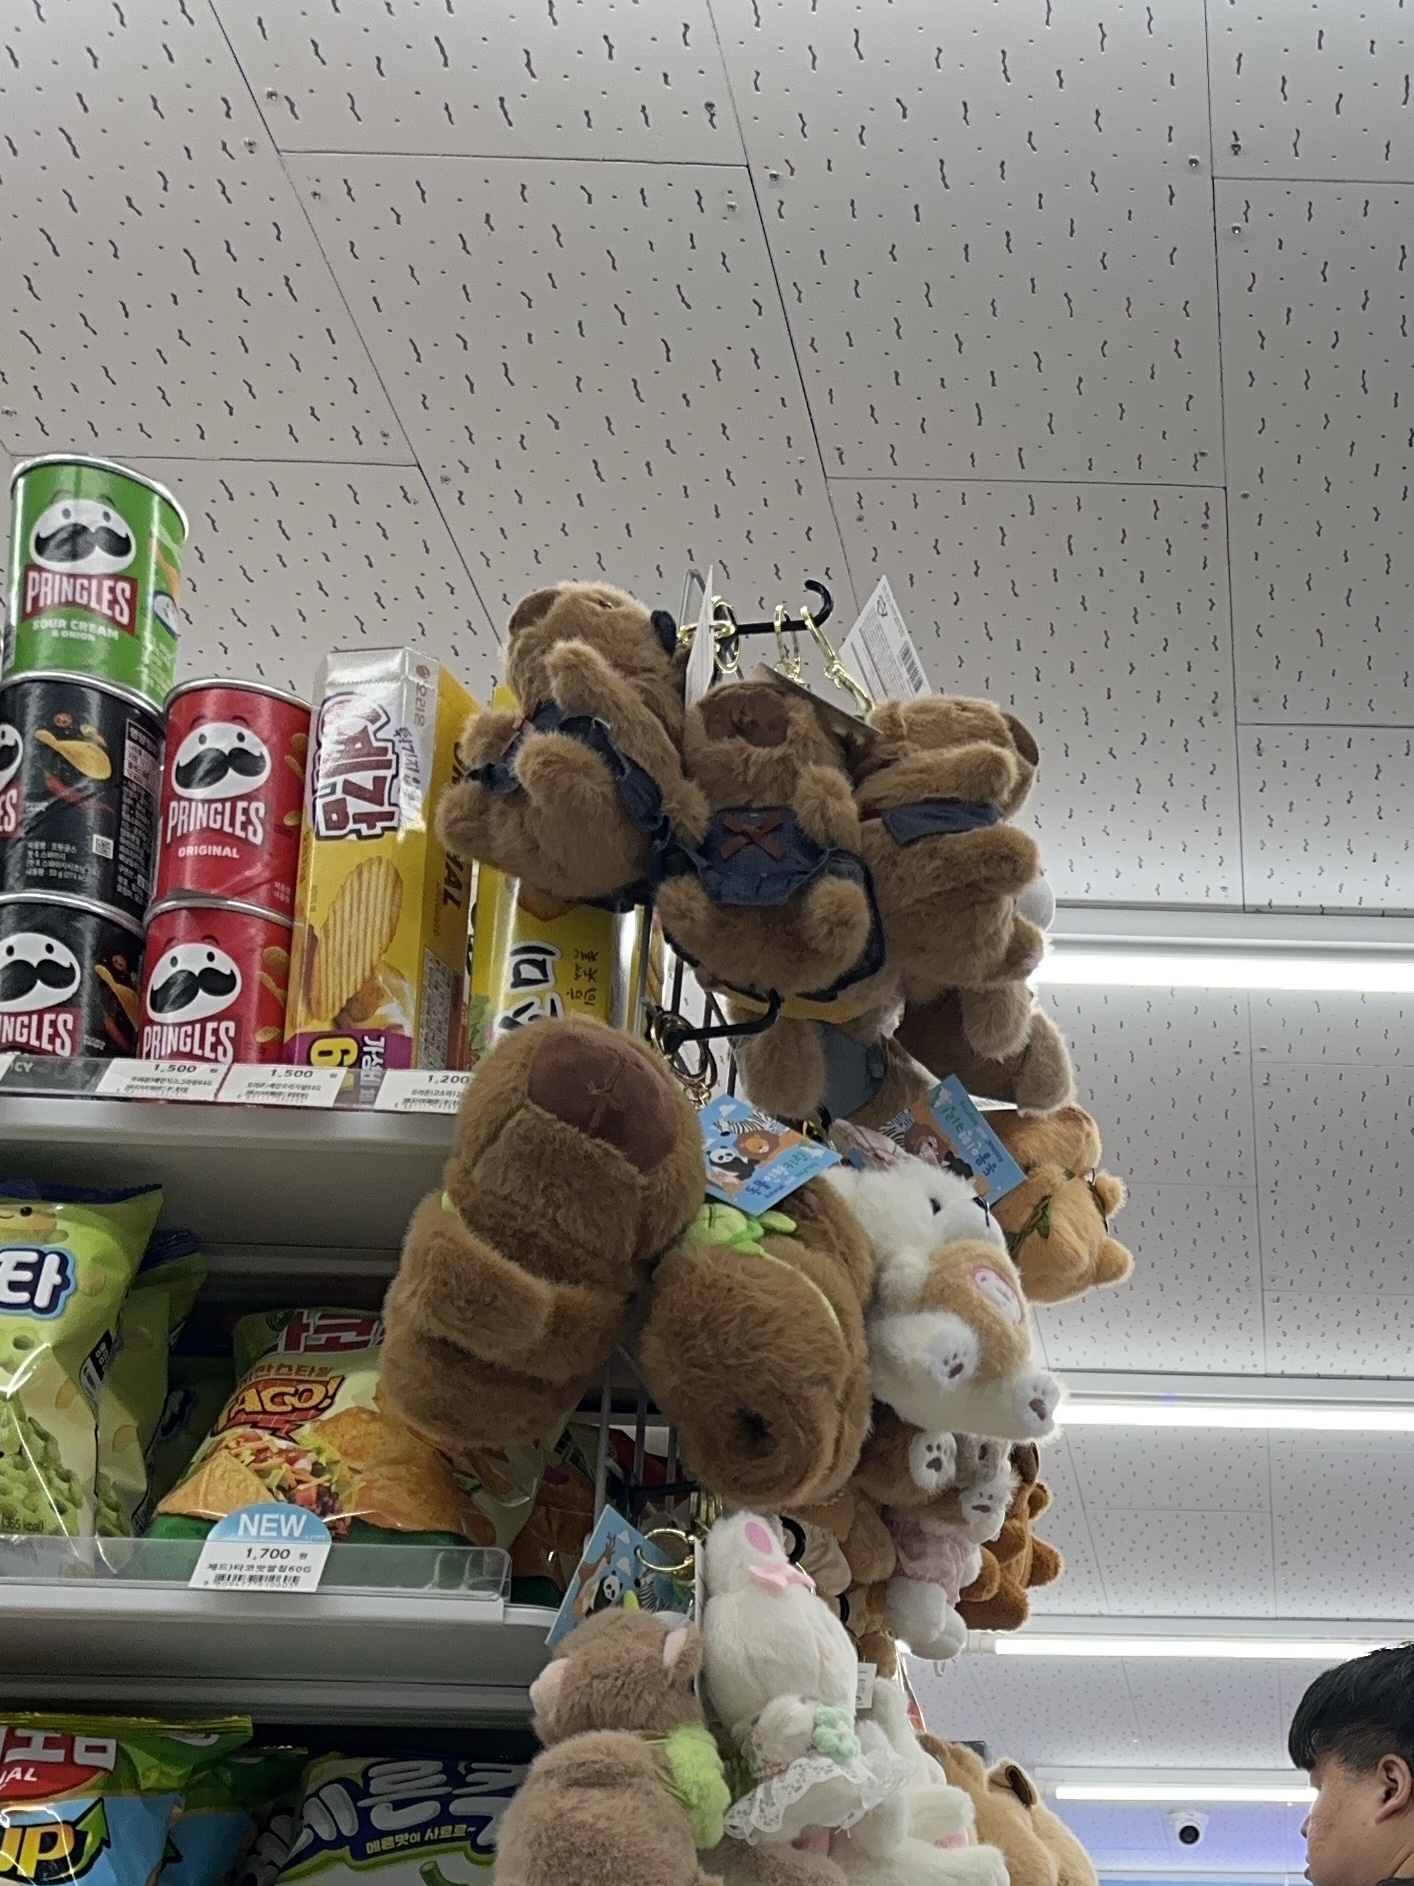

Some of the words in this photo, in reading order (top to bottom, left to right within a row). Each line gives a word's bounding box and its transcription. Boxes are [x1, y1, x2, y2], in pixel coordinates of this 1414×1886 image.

[26, 570, 131, 627] PRINGLES
[32, 618, 70, 632] SOUR
[70, 620, 119, 642] CREAM
[166, 800, 266, 846] PRINGLES
[177, 846, 240, 859] ORIGINAL
[0, 1014, 73, 1057] NGLES
[143, 1020, 236, 1064] PRINGLES
[153, 1063, 197, 1074] 1,500
[270, 1068, 314, 1079] 1,500
[427, 1074, 470, 1085] 1,200
[237, 1512, 308, 1538] NEW
[245, 1547, 291, 1560] 1,700
[298, 1552, 308, 1560] 원
[365, 1830, 422, 1856] 메론맛이
